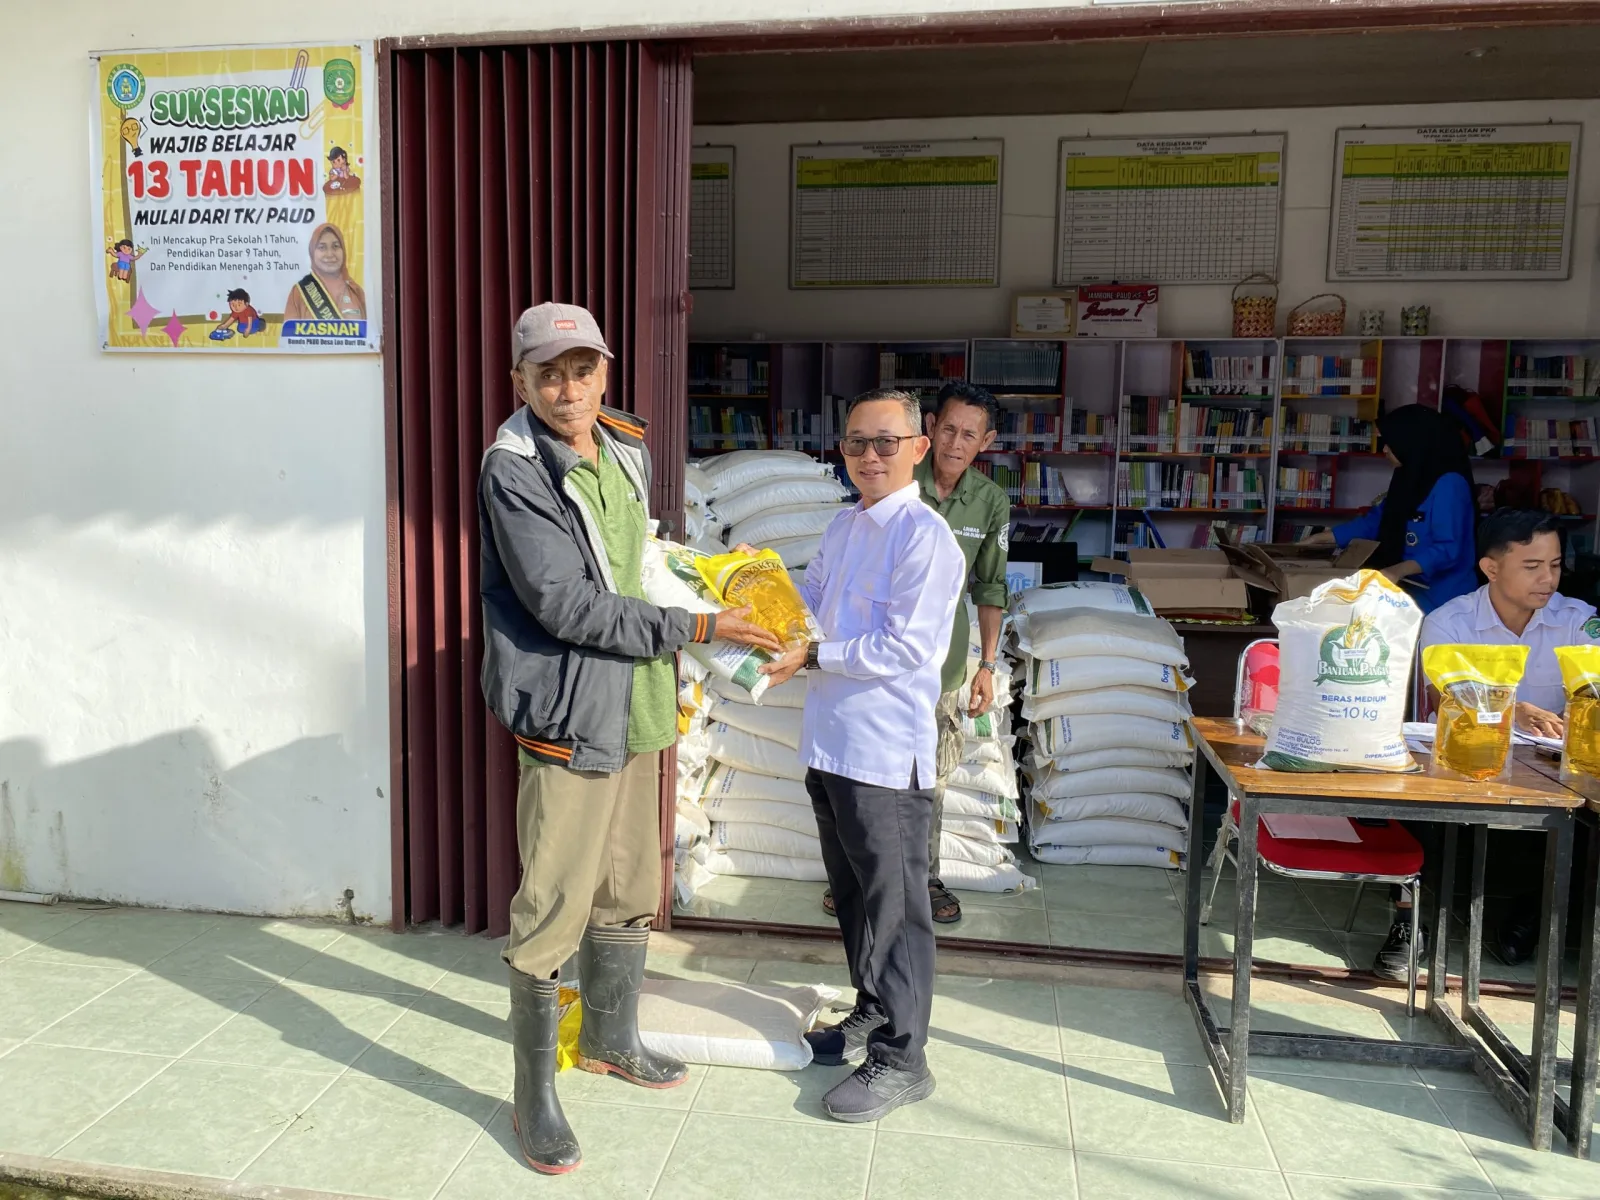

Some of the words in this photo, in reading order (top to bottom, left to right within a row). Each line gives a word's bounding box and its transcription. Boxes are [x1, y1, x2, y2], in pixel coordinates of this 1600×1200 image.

[152, 86, 308, 127] SUKSESKAN
[150, 136, 207, 153] WAJIB
[212, 133, 296, 152] BELAJAR
[128, 160, 170, 198] 13
[179, 158, 315, 198] TAHUN
[134, 209, 186, 225] MULAI
[188, 208, 230, 224] DARI
[234, 208, 263, 225] TK/
[267, 207, 315, 223] PAUD
[150, 236, 160, 245] Ini
[163, 236, 207, 246] Mencakup
[210, 236, 225, 244] Pra
[227, 235, 263, 244] Sekolah
[264, 235, 268, 244] 1
[270, 234, 299, 244] Tahun,
[167, 249, 215, 258] Pendidikan
[217, 249, 243, 257] Dasar
[245, 248, 251, 257] 9
[253, 248, 281, 258] Tahun,
[150, 262, 166, 271] Dan
[168, 262, 217, 271] Pendidikan
[220, 262, 264, 273] Menengah
[266, 262, 271, 270] 3
[274, 261, 300, 270] Tahun
[1082, 301, 1129, 320] Juara
[1134, 302, 1146, 317] 1
[295, 321, 360, 336] KASNAH
[1321, 694, 1352, 702] BERAS
[1354, 695, 1387, 703] MEDIUM
[1342, 706, 1360, 719] 10
[1362, 707, 1378, 721] kg
[1297, 735, 1322, 746] BULOG
